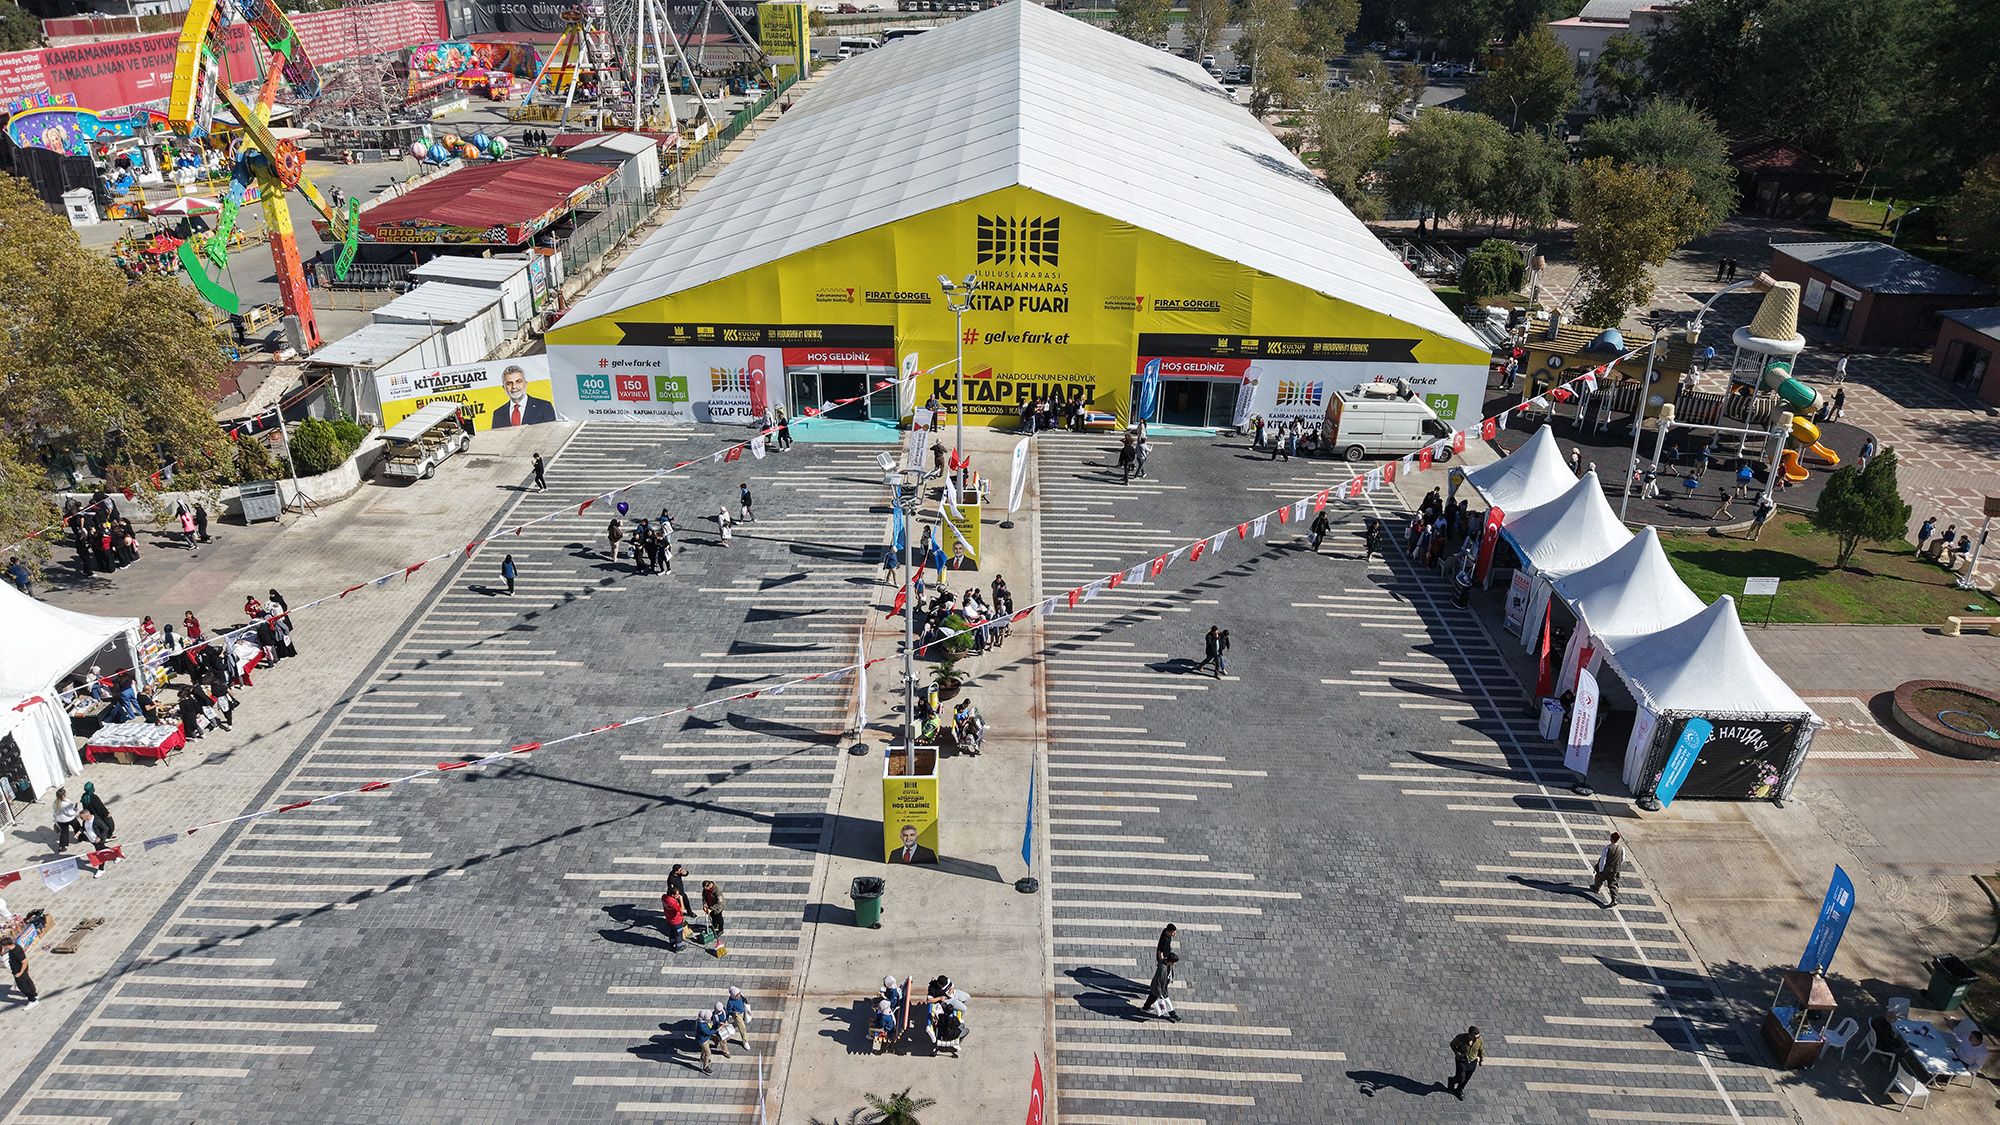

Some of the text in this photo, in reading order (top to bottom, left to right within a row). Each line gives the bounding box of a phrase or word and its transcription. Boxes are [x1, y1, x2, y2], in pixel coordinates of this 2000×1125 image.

[487, 4, 527, 14] UNESCO
[45, 43, 141, 66] KAHRAMANMARAŞ
[51, 52, 175, 83] TAMAMLANAN VE DEVAM
[11, 94, 69, 110] TURBULENCE
[378, 228, 415, 237] AUTO
[974, 281, 1068, 296] AHRAMANMARAŞ
[894, 290, 931, 300] GÖRGEL
[1020, 296, 1069, 312] FUARI
[1183, 298, 1220, 308] GÖRGEL
[984, 330, 1006, 344] gel
[1021, 331, 1053, 344] fark
[1054, 333, 1070, 344] et
[808, 352, 870, 362] HOŞ GELDİNİZ
[612, 360, 624, 368] gel
[652, 360, 661, 368] et
[1162, 362, 1225, 372] HOŞ GELDİNİZ
[414, 374, 452, 390] KİTAP
[451, 370, 488, 385] FUARI
[996, 372, 1056, 381] ANADOLU'NUN
[1069, 372, 1096, 382] BÜYÜK
[1408, 376, 1428, 385] fark
[583, 380, 604, 389] 400
[623, 380, 642, 390] 150
[664, 381, 678, 391] 50
[933, 374, 1096, 405] KİTAP FUARI
[619, 390, 648, 398] YAYINEVİ
[660, 391, 686, 400] SÖYLEŞİ
[1434, 399, 1448, 408] 50
[708, 407, 736, 416] KİTAP
[970, 405, 988, 414] EKİM
[988, 406, 1004, 414] 2026
[1302, 422, 1324, 430] UARI
